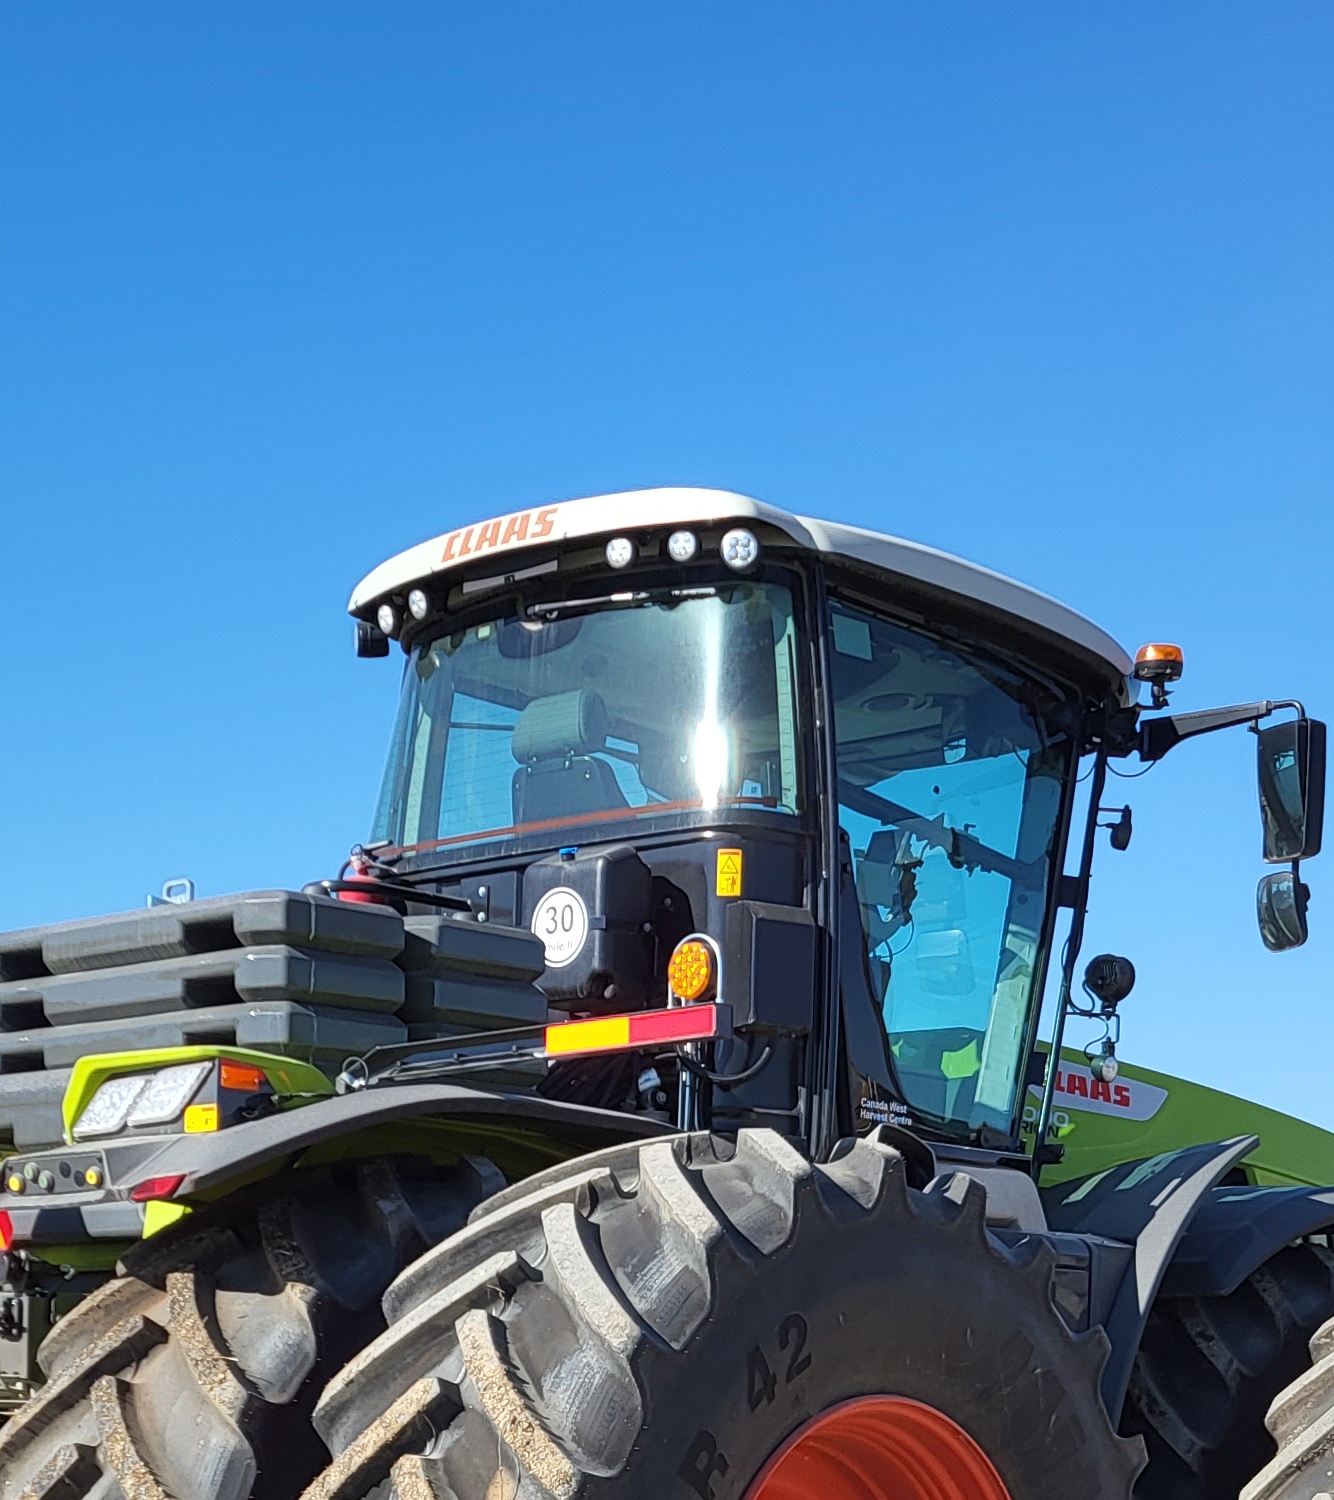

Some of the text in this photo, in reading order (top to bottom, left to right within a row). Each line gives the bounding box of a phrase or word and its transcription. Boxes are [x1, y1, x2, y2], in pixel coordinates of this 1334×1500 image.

[441, 507, 558, 563] CLAAS
[546, 904, 574, 934] 30
[1054, 1071, 1130, 1107] LAAS
[860, 1098, 907, 1114] Canada West
[860, 1109, 888, 1122] Harvest
[746, 1313, 812, 1414] 42
